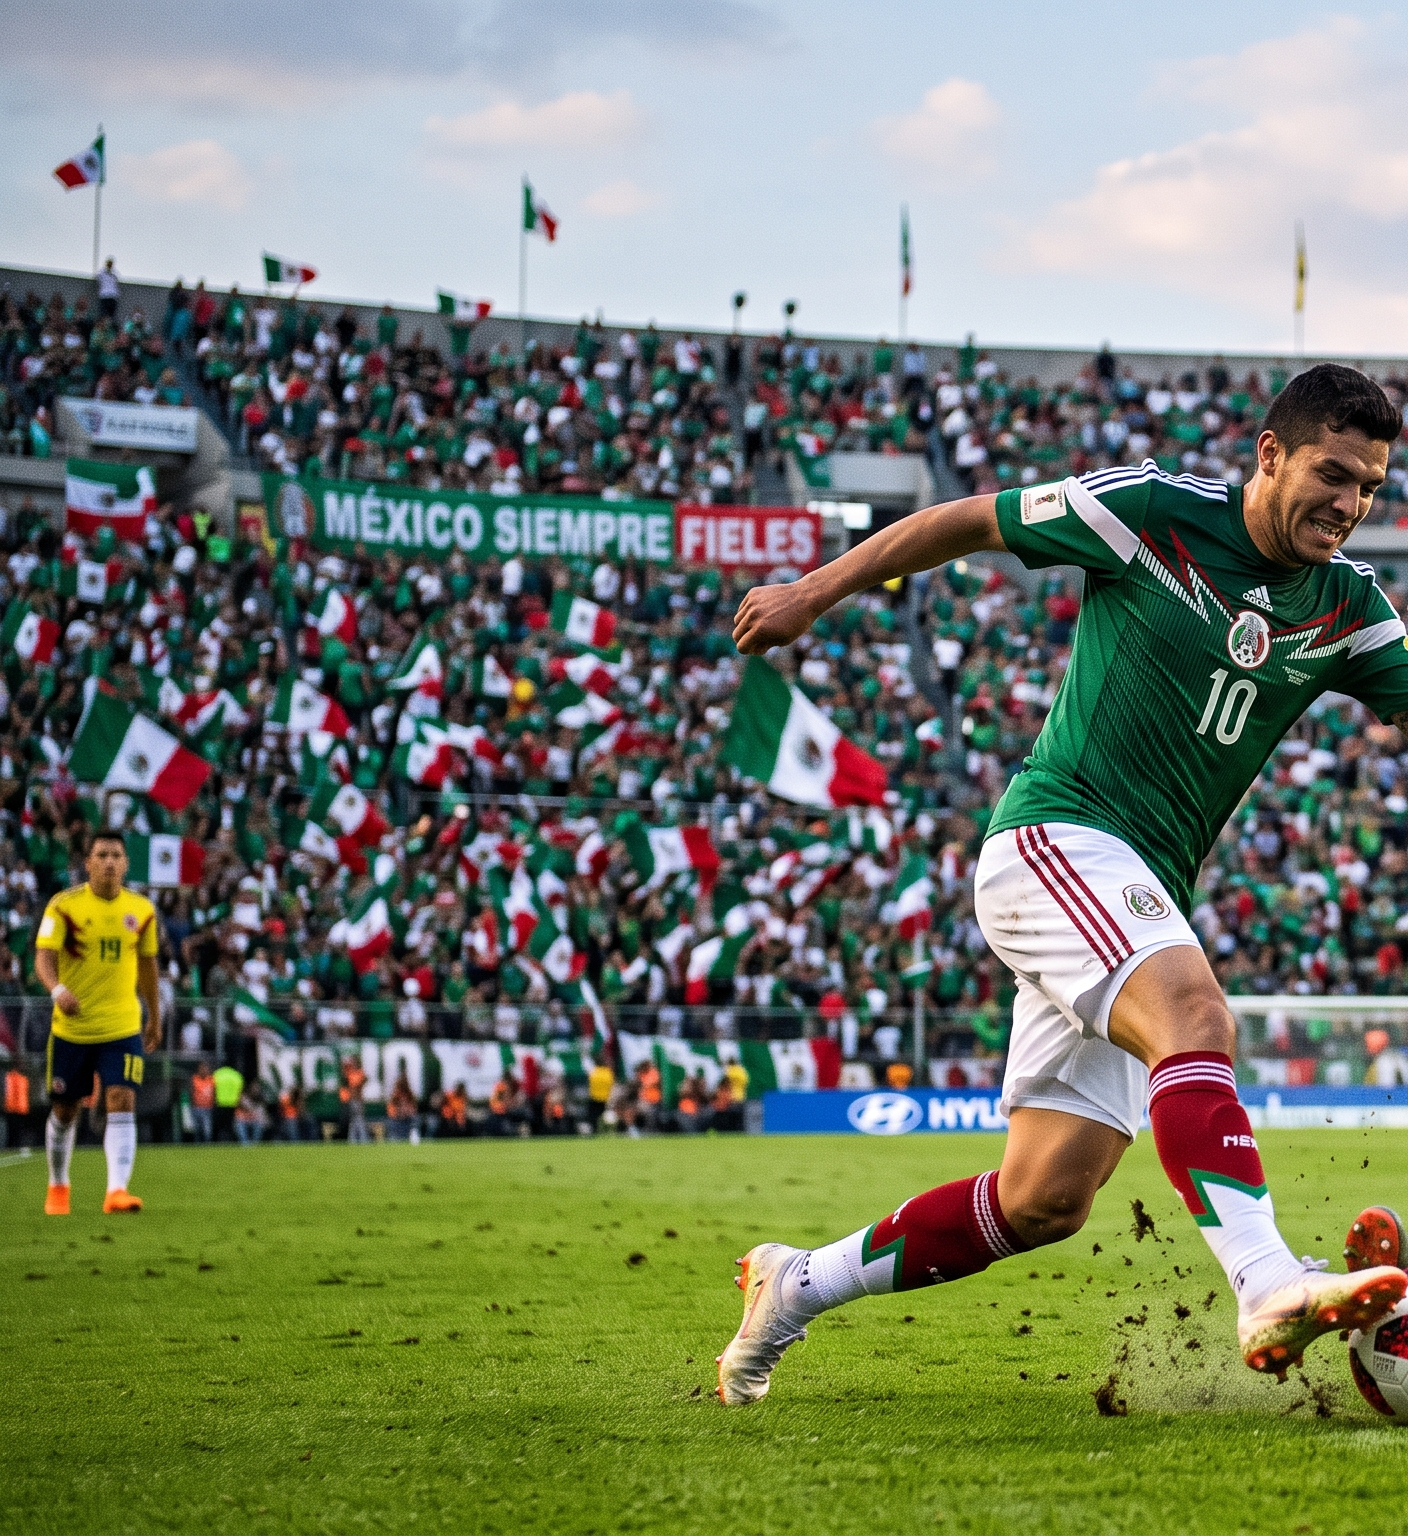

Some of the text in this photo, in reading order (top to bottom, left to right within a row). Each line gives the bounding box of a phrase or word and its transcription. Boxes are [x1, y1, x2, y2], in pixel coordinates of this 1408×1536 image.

[323, 484, 815, 565] MÉXICO SIEMPRE FIELES
[1195, 667, 1258, 745] 10
[99, 938, 121, 962] 19
[928, 1096, 1010, 1129] HYU
